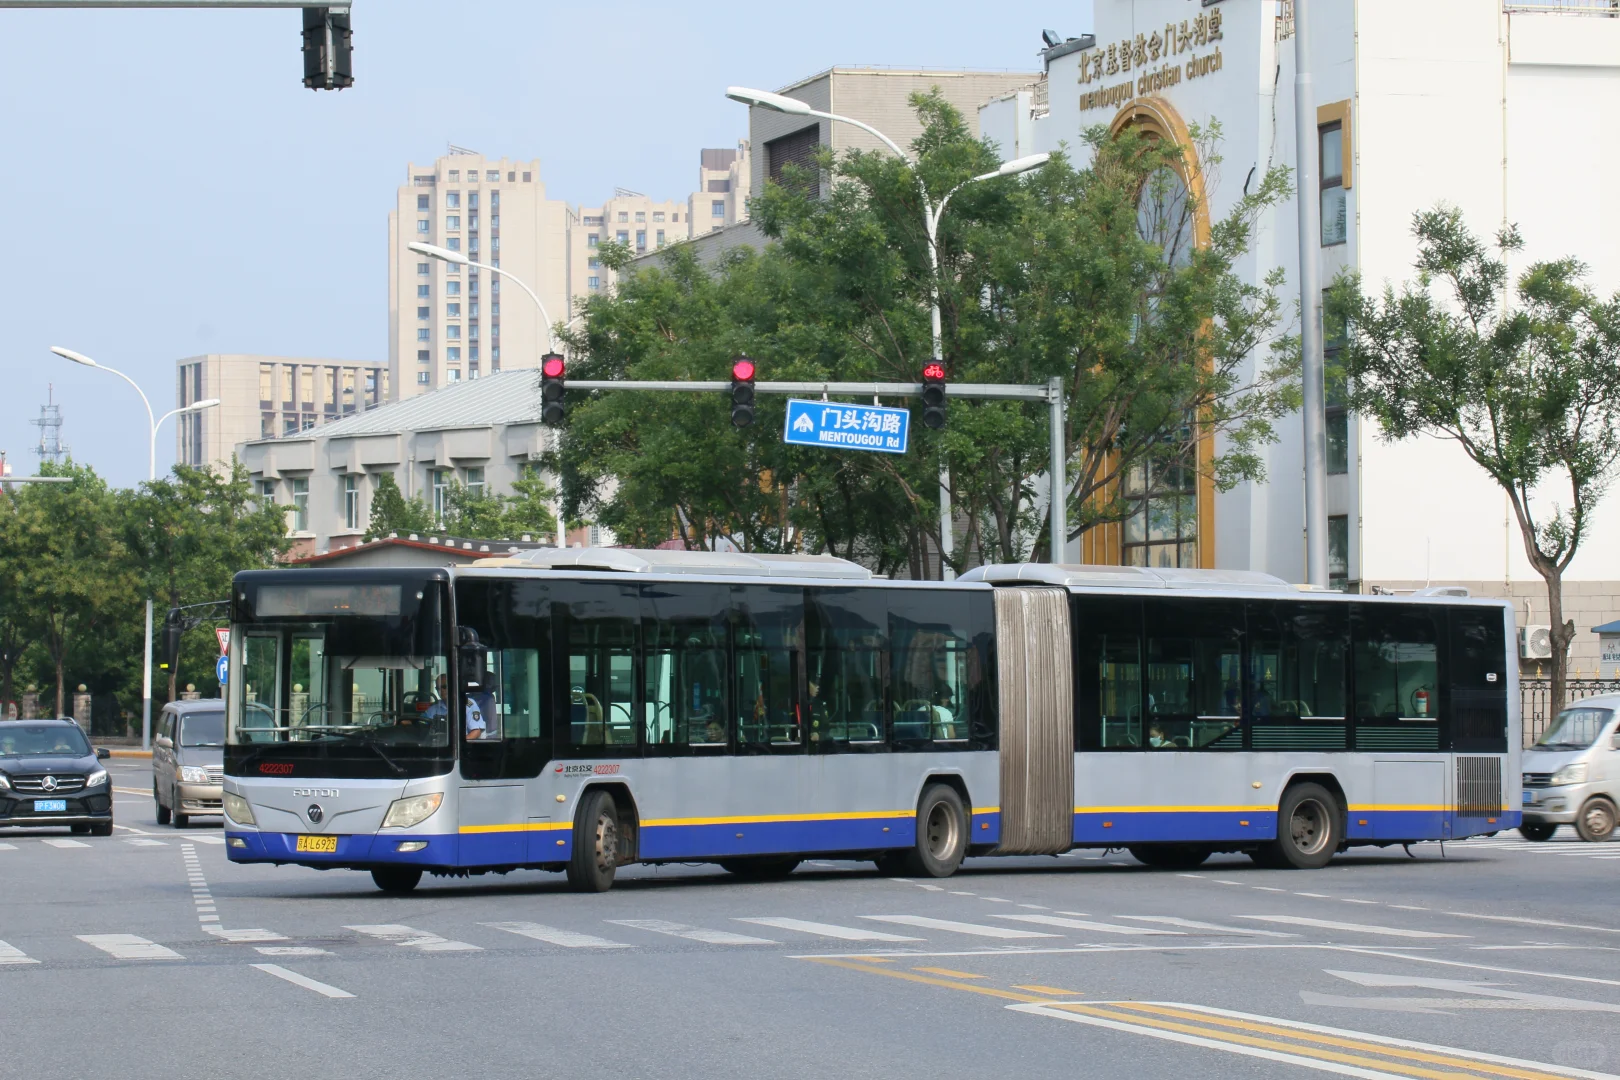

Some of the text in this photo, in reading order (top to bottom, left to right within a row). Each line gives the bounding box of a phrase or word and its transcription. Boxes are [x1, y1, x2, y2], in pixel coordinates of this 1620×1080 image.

[1078, 7, 1223, 84] 北京基督教会门头沟堂
[1079, 46, 1222, 112] mentougou christian church
[820, 407, 901, 434] 门头沟路
[819, 430, 900, 448] MENTOUGOU Rd
[259, 763, 294, 774] 4222307
[565, 764, 620, 775] 北京公交 4222307
[293, 788, 340, 798] FOTON
